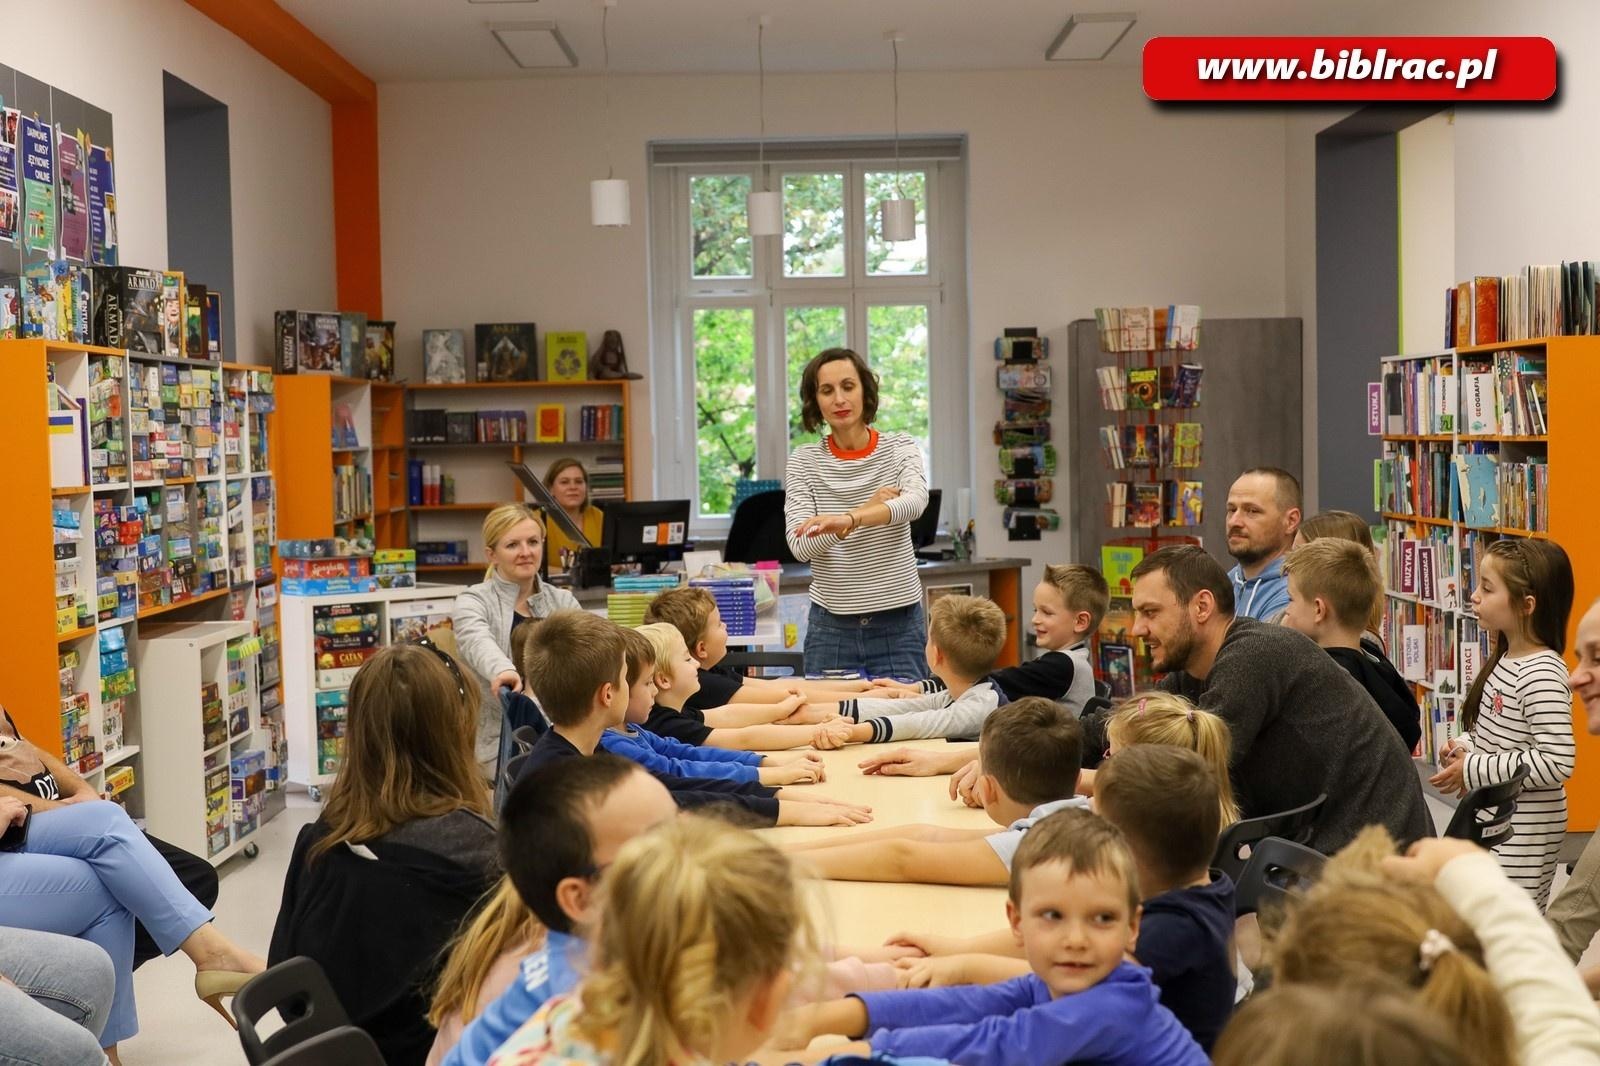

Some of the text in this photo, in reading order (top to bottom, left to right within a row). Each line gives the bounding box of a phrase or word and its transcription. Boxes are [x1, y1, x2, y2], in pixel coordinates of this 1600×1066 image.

[81, 291, 90, 335] CENTURY
[1371, 391, 1379, 427] SZTUKA
[1474, 376, 1482, 417] GEOGRAFIA
[1404, 547, 1412, 587] MUZYKA
[339, 652, 364, 663] CATAN
